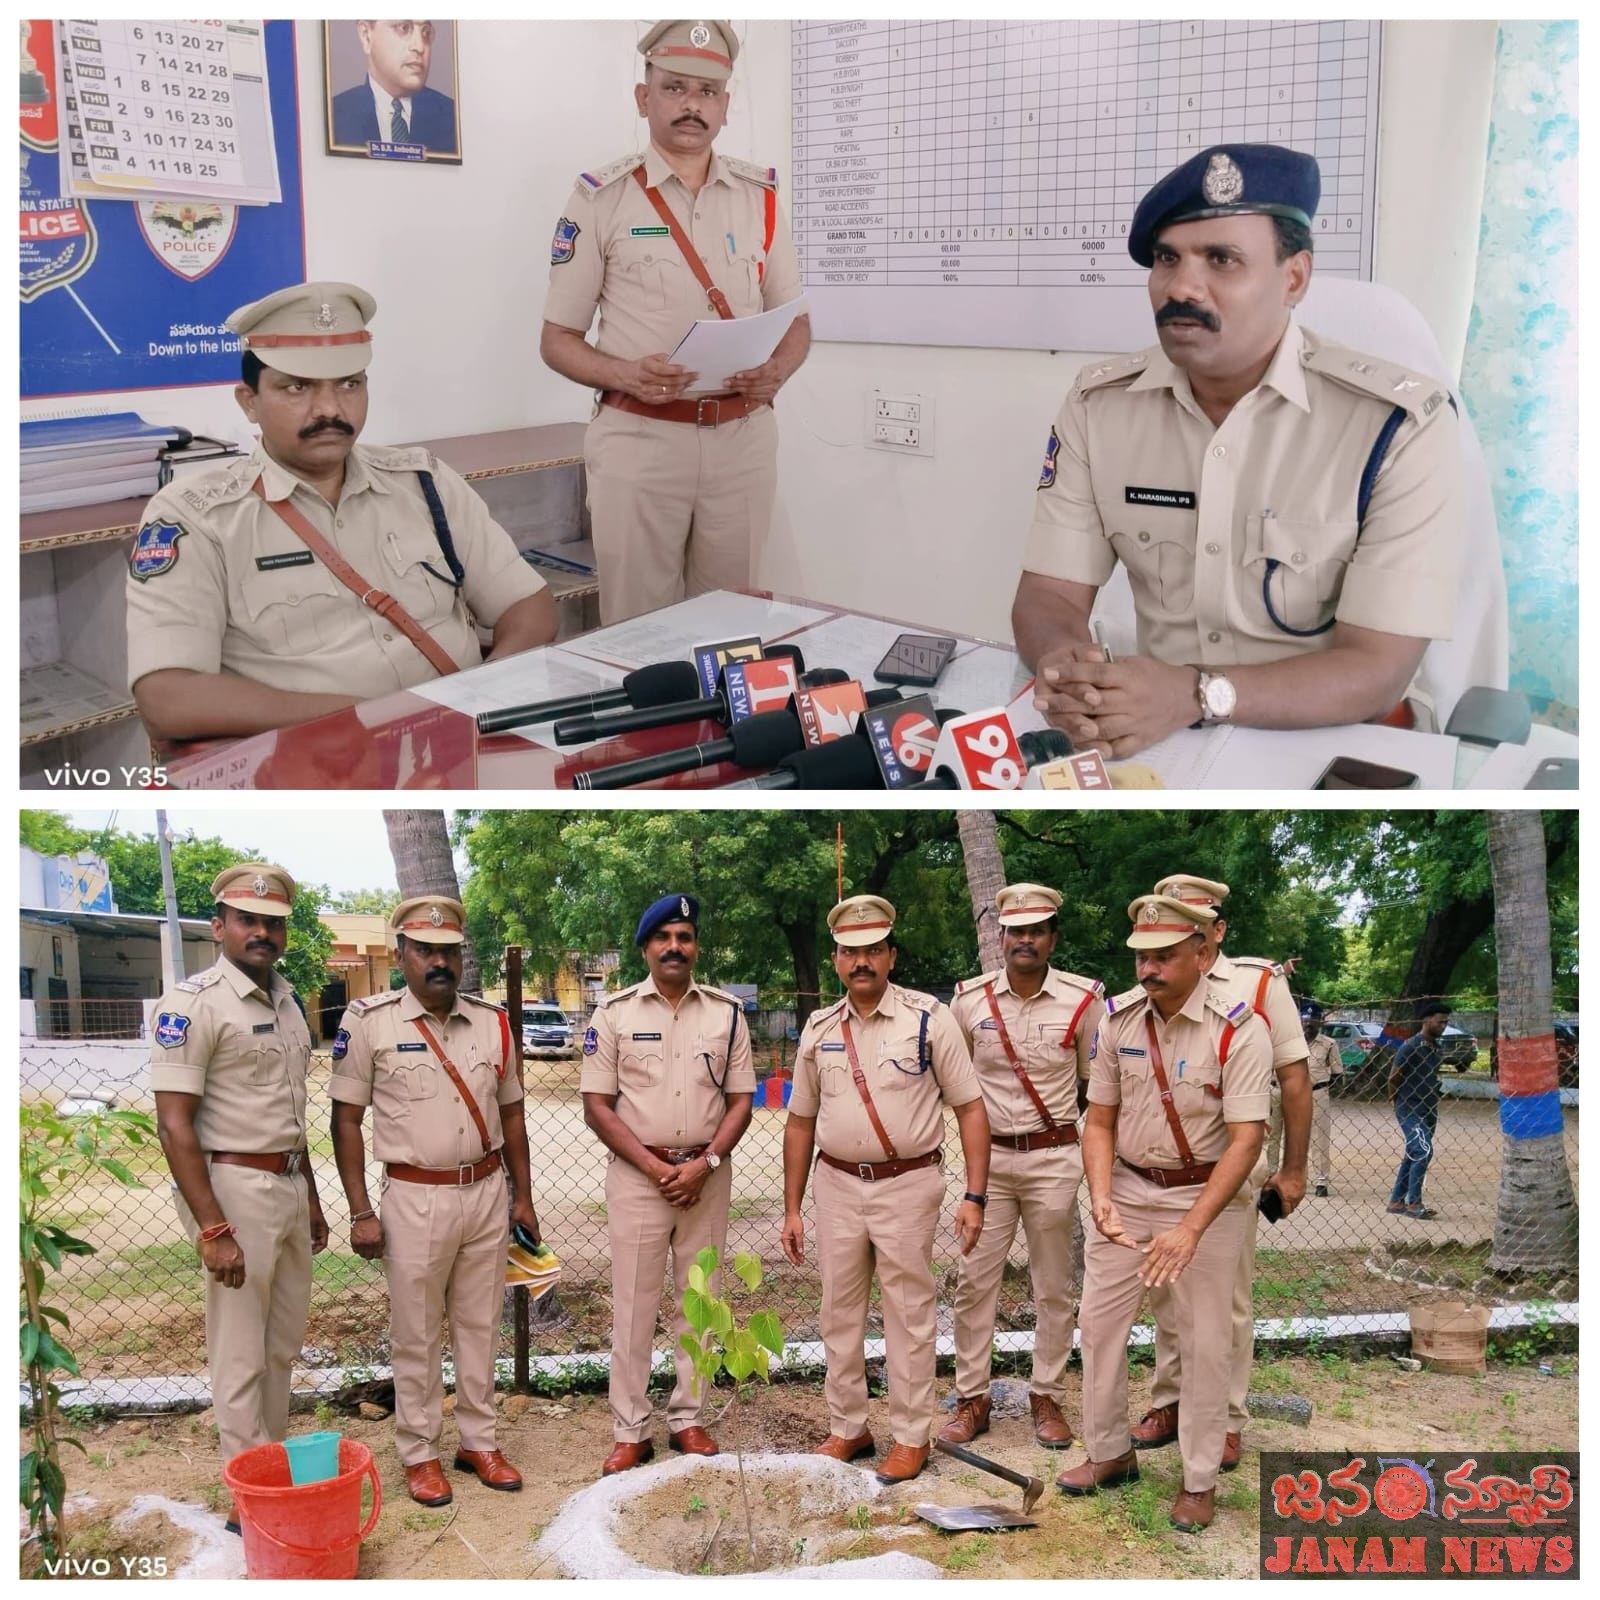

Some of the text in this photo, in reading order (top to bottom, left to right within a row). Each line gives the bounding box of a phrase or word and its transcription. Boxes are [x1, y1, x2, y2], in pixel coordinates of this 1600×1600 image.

[1190, 24, 1195, 34] 1
[133, 27, 224, 52] 6 13 20 27
[75, 38, 100, 50] TUE
[136, 53, 146, 66] 7
[158, 57, 178, 70] 14
[184, 60, 202, 74] 21
[208, 64, 228, 78] 28
[78, 66, 104, 78] WED
[114, 76, 122, 88] 1
[141, 79, 151, 92] 8
[162, 82, 181, 96] 15
[187, 86, 207, 100] 22
[211, 89, 230, 103] 29
[1187, 97, 1193, 107] 6
[83, 93, 107, 105] THU
[117, 102, 128, 115] 2
[143, 106, 154, 118] 9
[165, 109, 184, 122] 16
[191, 112, 210, 126] 23
[214, 115, 233, 128] 30
[89, 121, 109, 132] FRI
[121, 129, 132, 142] 3
[144, 132, 163, 146] 10
[169, 135, 187, 148] 17
[194, 138, 214, 151] 24
[218, 141, 235, 154] 31
[1186, 133, 1191, 144] 1
[833, 144, 860, 153] CHEATING
[75, 155, 88, 165] SA
[94, 147, 116, 159] SAT
[126, 156, 137, 168] 4
[148, 159, 166, 171] 11
[173, 161, 193, 174] 18
[199, 163, 218, 177] 25
[20, 198, 72, 211] NA STATE
[20, 213, 80, 236] LICE
[827, 231, 847, 240] GRAND
[848, 231, 866, 239] TOTAL
[908, 231, 913, 239] 0
[940, 230, 945, 238] 0
[957, 229, 962, 238] 0
[973, 228, 978, 237] 0
[1008, 227, 1013, 237] 0
[1024, 227, 1033, 236] 14
[1044, 226, 1049, 236] 0
[1062, 226, 1067, 235] 0
[1082, 225, 1087, 234] 0
[1101, 224, 1106, 234] 7
[1121, 224, 1126, 234] 0
[1321, 218, 1328, 229] 0
[1346, 217, 1352, 229] 0
[20, 242, 34, 250] uty
[163, 241, 216, 252] POLICE
[853, 245, 867, 254] LOST
[1081, 241, 1105, 250] 60000
[845, 259, 876, 268] RECOVERED
[1090, 257, 1096, 266] 0
[943, 274, 959, 282] 100%
[1080, 273, 1106, 282] 0.00%
[148, 338, 241, 357] Down to the last
[135, 550, 172, 560] POLICE
[729, 672, 749, 722] NEW
[899, 719, 938, 768] V6
[872, 720, 901, 781] NEWS
[158, 1027, 184, 1037] POLICE
